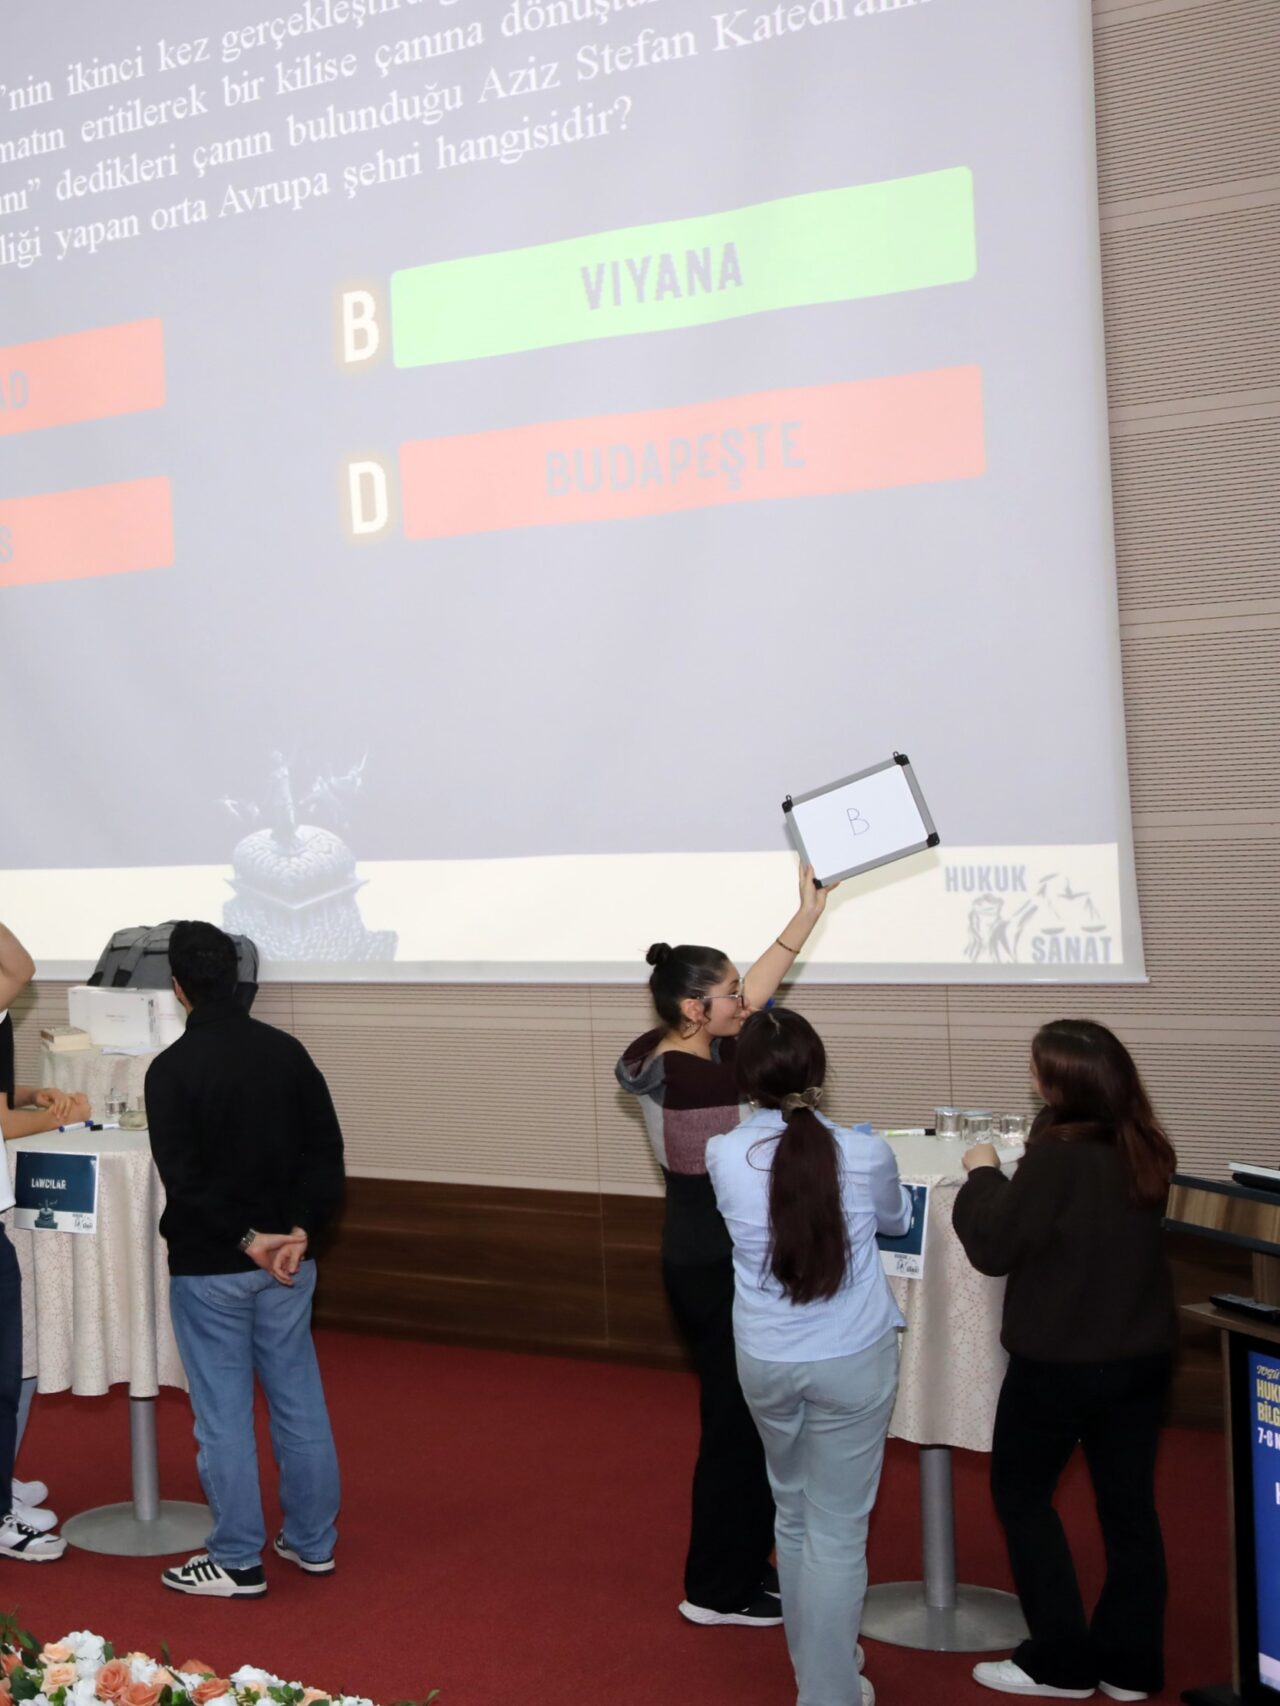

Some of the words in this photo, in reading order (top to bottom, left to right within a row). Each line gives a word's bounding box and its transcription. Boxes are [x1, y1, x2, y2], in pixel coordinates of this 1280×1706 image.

[66, 45, 145, 97] ikinci
[157, 37, 211, 73] kez
[81, 83, 209, 143] eritilerek
[221, 70, 265, 107] bir
[275, 51, 358, 95] kilise
[374, 20, 486, 78] çanına
[56, 143, 179, 202] dedikleri
[192, 129, 274, 178] çanın
[285, 82, 464, 148] bulunduğu
[477, 55, 562, 104] Aziz
[576, 27, 700, 82] Stefan
[54, 213, 141, 261] yapan
[150, 195, 209, 232] orta
[217, 169, 331, 218] Avrupa
[343, 141, 423, 199] şehri
[435, 95, 633, 170] hangisidir?
[342, 288, 380, 364] B
[579, 242, 744, 311] VIYANA
[347, 459, 389, 536] D
[543, 419, 806, 491] BUDAPEŞTE
[845, 807, 871, 836] B
[944, 865, 1027, 893] HUKUK
[1031, 935, 1113, 964] SANAT
[1257, 1426, 1274, 1448] 7-8
